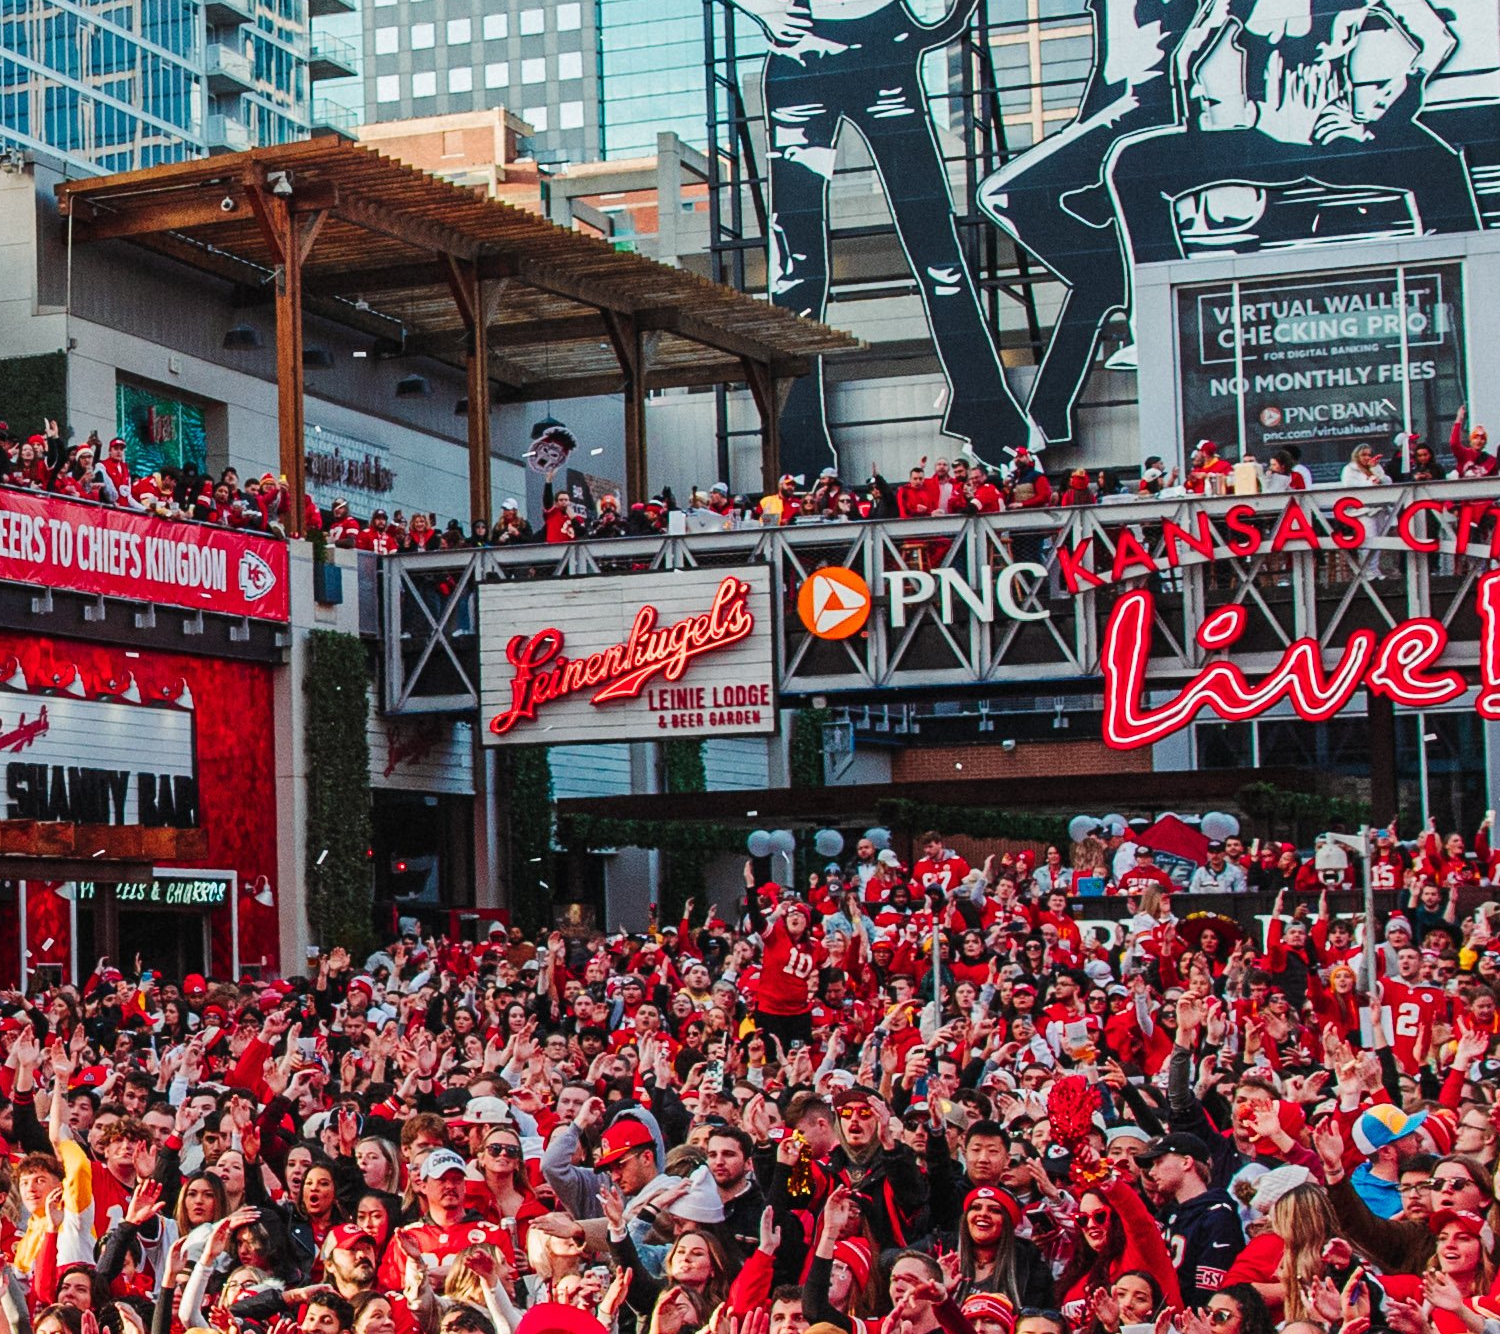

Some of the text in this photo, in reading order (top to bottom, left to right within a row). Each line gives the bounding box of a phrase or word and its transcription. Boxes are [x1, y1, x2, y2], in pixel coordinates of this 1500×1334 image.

[1213, 288, 1424, 326] VIRTUAL WALLET
[1216, 312, 1428, 350] CHECKING PRO
[1263, 342, 1380, 361] FOR DIGITAL BANKING
[1210, 360, 1437, 397] NO MONTHLY FEES
[1283, 399, 1389, 423] PNC BANK
[1262, 422, 1390, 443] pnc.com/virtualwallet
[47, 523, 74, 568] TO
[76, 524, 143, 578] CHIEFS
[145, 538, 228, 592] KINGDOM
[1056, 496, 1367, 595] KANSAS
[883, 561, 1052, 628] PNC
[489, 576, 753, 734] Leinenkugel's
[649, 683, 770, 712] LEINIE LODGE
[657, 709, 761, 729] & BEER GARDEN
[6, 761, 197, 829] SHANDY BAR
[151, 882, 162, 902] &
[166, 881, 227, 906] CHURROS
[782, 947, 813, 979] 10
